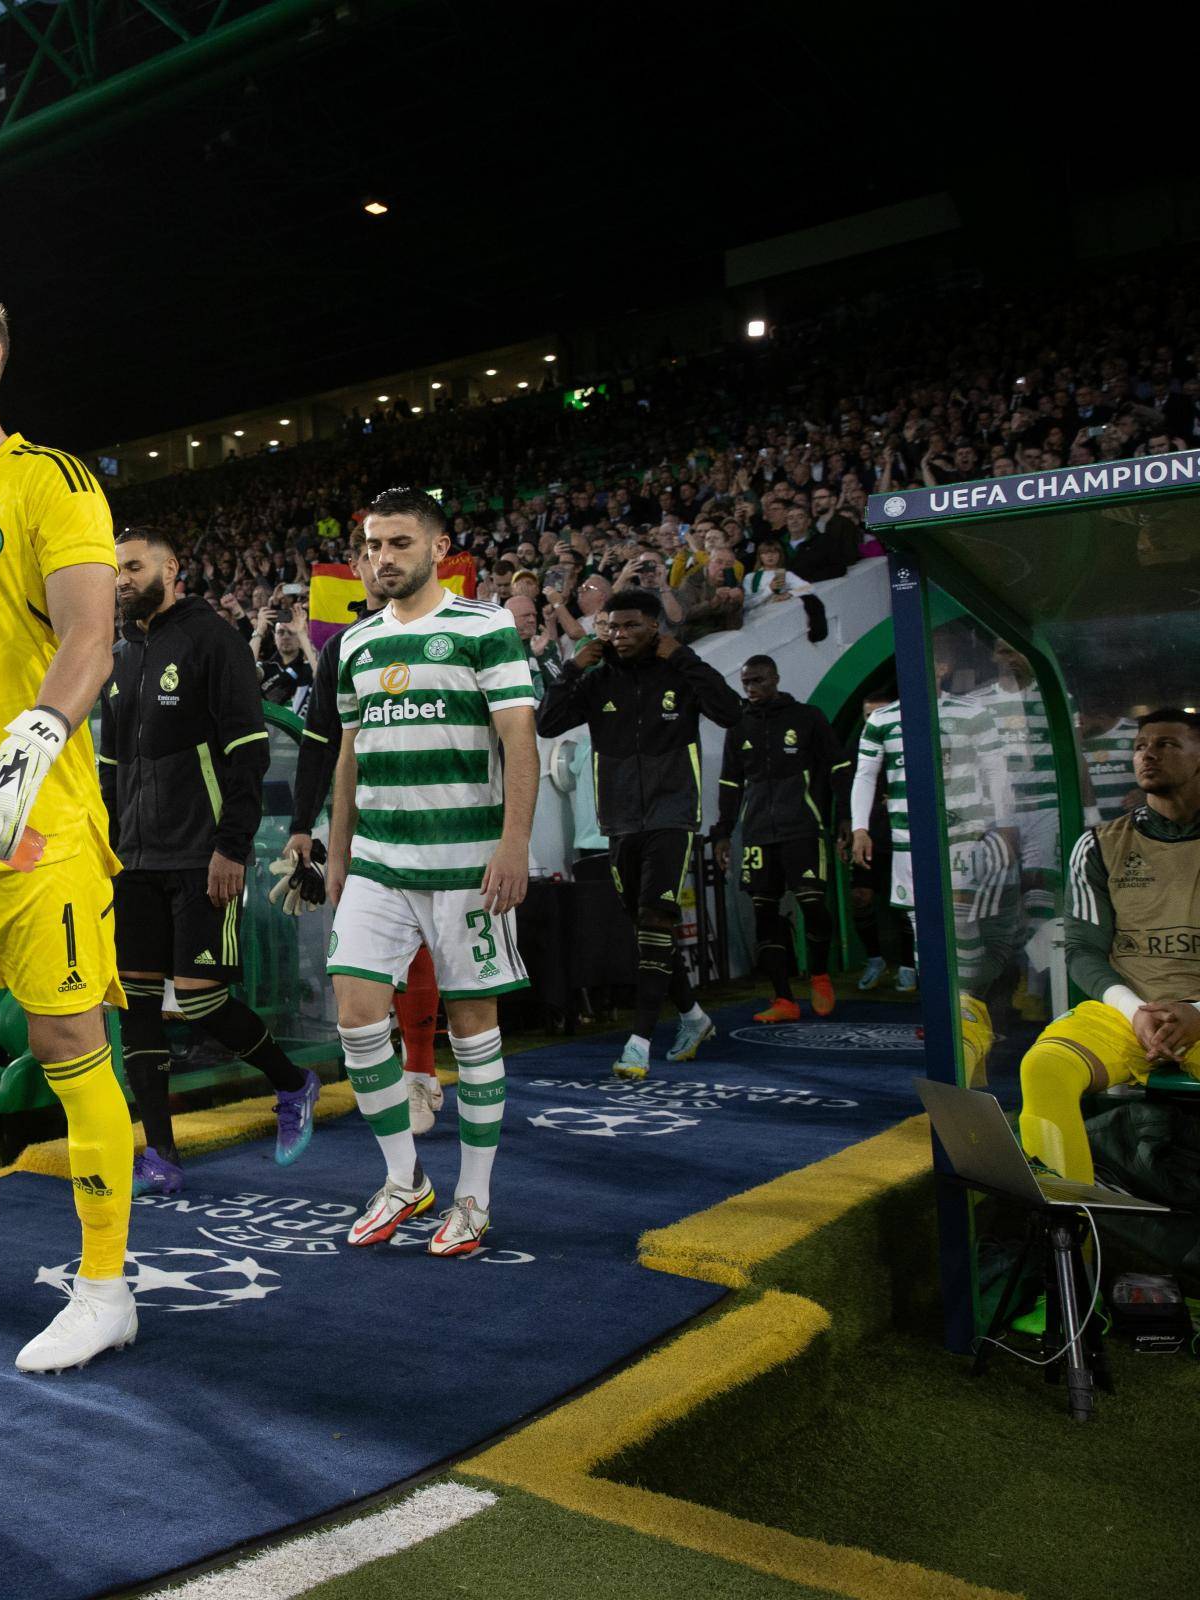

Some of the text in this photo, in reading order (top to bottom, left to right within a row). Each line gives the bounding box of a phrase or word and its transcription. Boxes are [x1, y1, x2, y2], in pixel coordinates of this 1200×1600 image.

[930, 456, 1200, 512] UEFA CHAMPION
[742, 846, 763, 870] 23
[61, 902, 77, 968] 1
[466, 909, 497, 962] 3
[57, 982, 87, 993] adidas
[461, 1086, 504, 1098] CELTIC
[528, 1079, 859, 1108] CHAMPIONS
[617, 1094, 719, 1108] UEFA
[213, 1225, 337, 1251] UEFA
